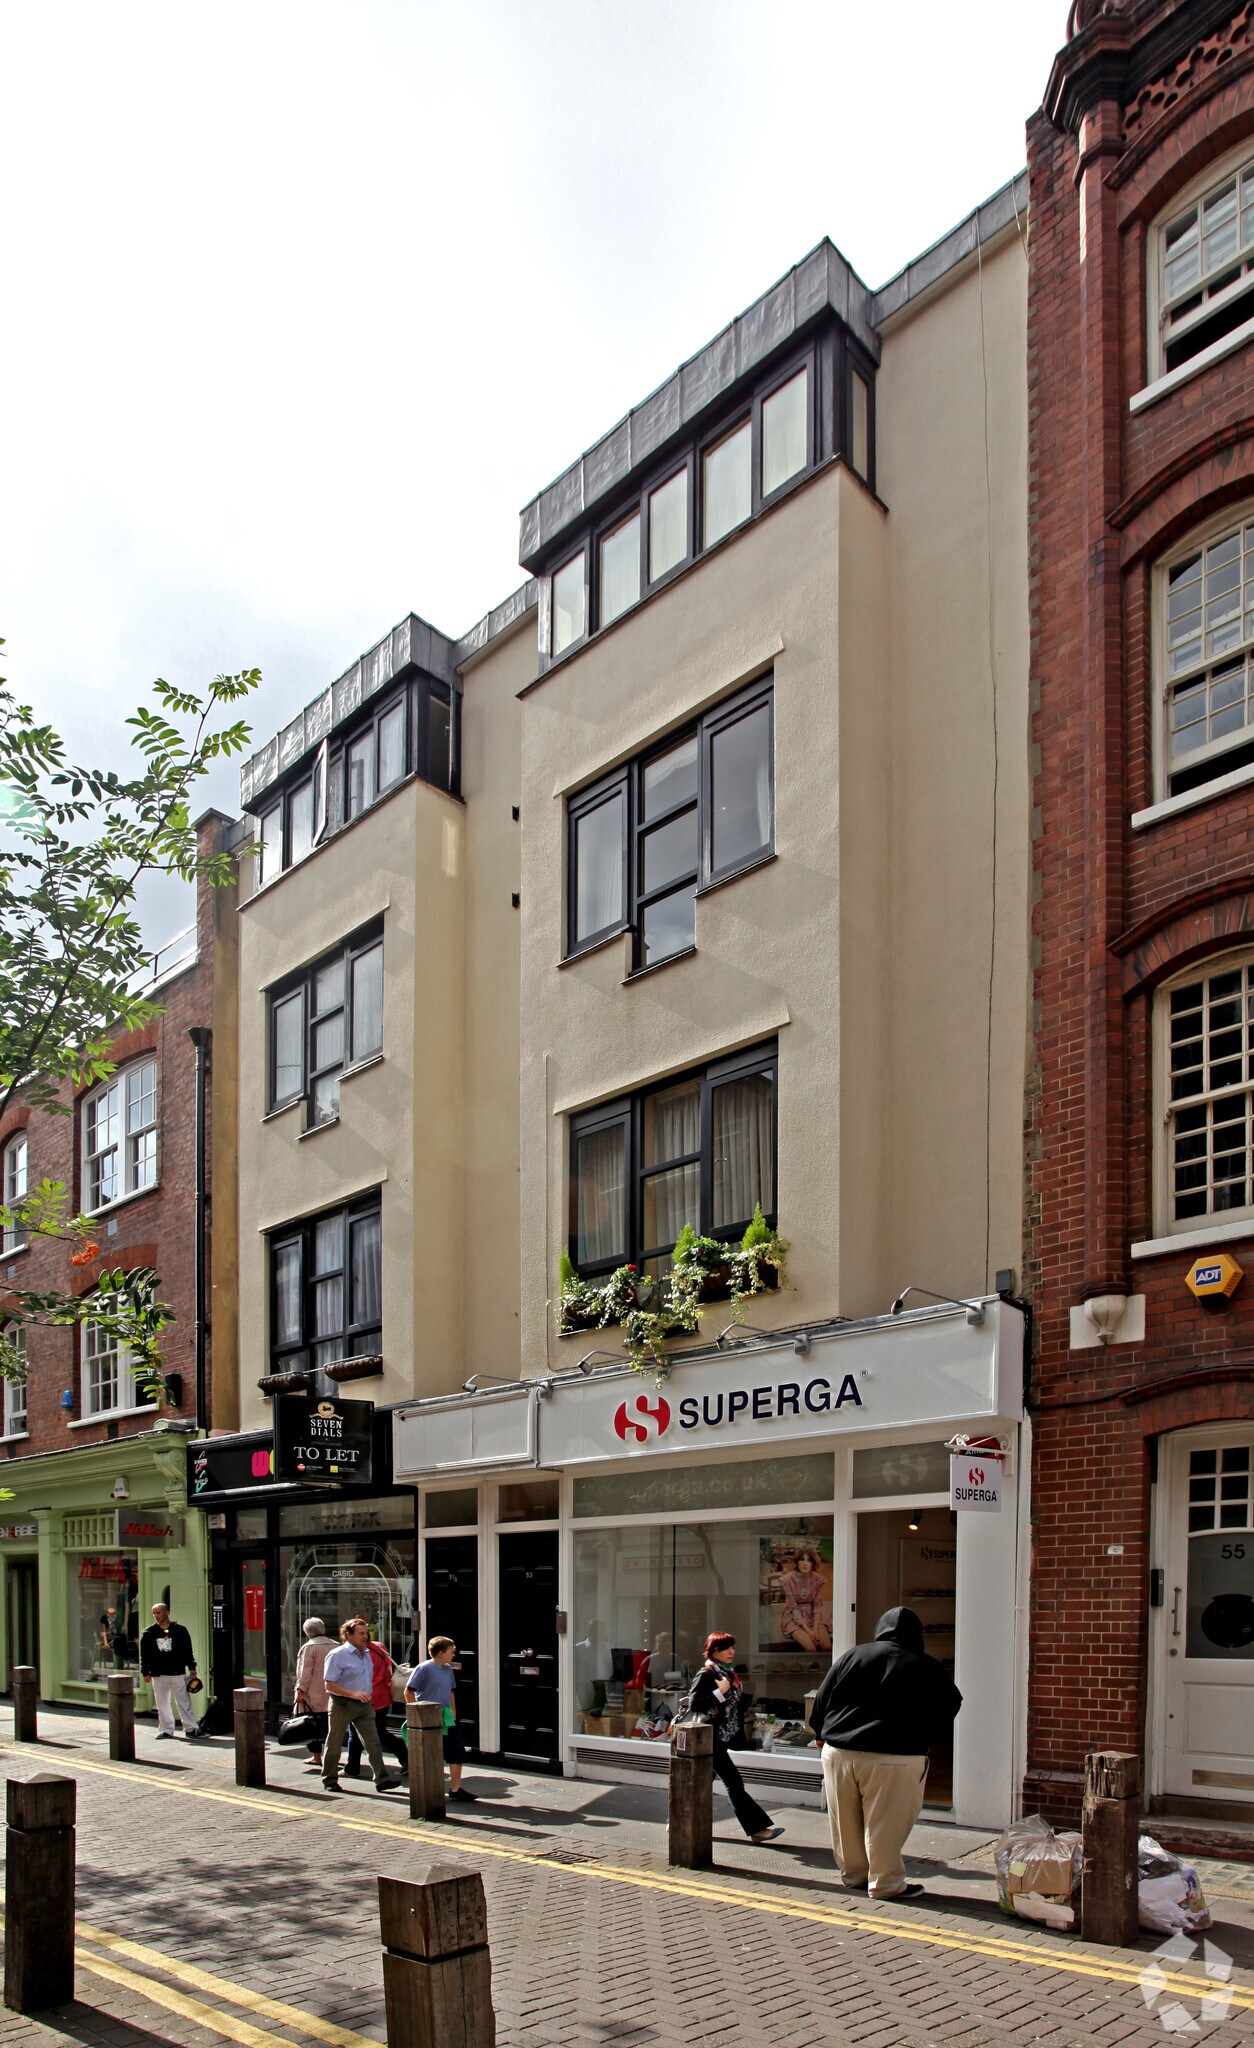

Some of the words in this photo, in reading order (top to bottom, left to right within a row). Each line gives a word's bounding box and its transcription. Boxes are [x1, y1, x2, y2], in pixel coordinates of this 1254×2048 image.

[1196, 1269, 1222, 1282] ADT
[310, 1419, 342, 1429] SEVEN
[310, 1428, 343, 1438] DIALS
[293, 1446, 320, 1460] TO
[325, 1448, 360, 1462] LET
[955, 1487, 998, 1502] SUPERGA
[124, 1522, 175, 1537] Killah
[1221, 1543, 1246, 1560] 55
[331, 1570, 355, 1578] CASIO
